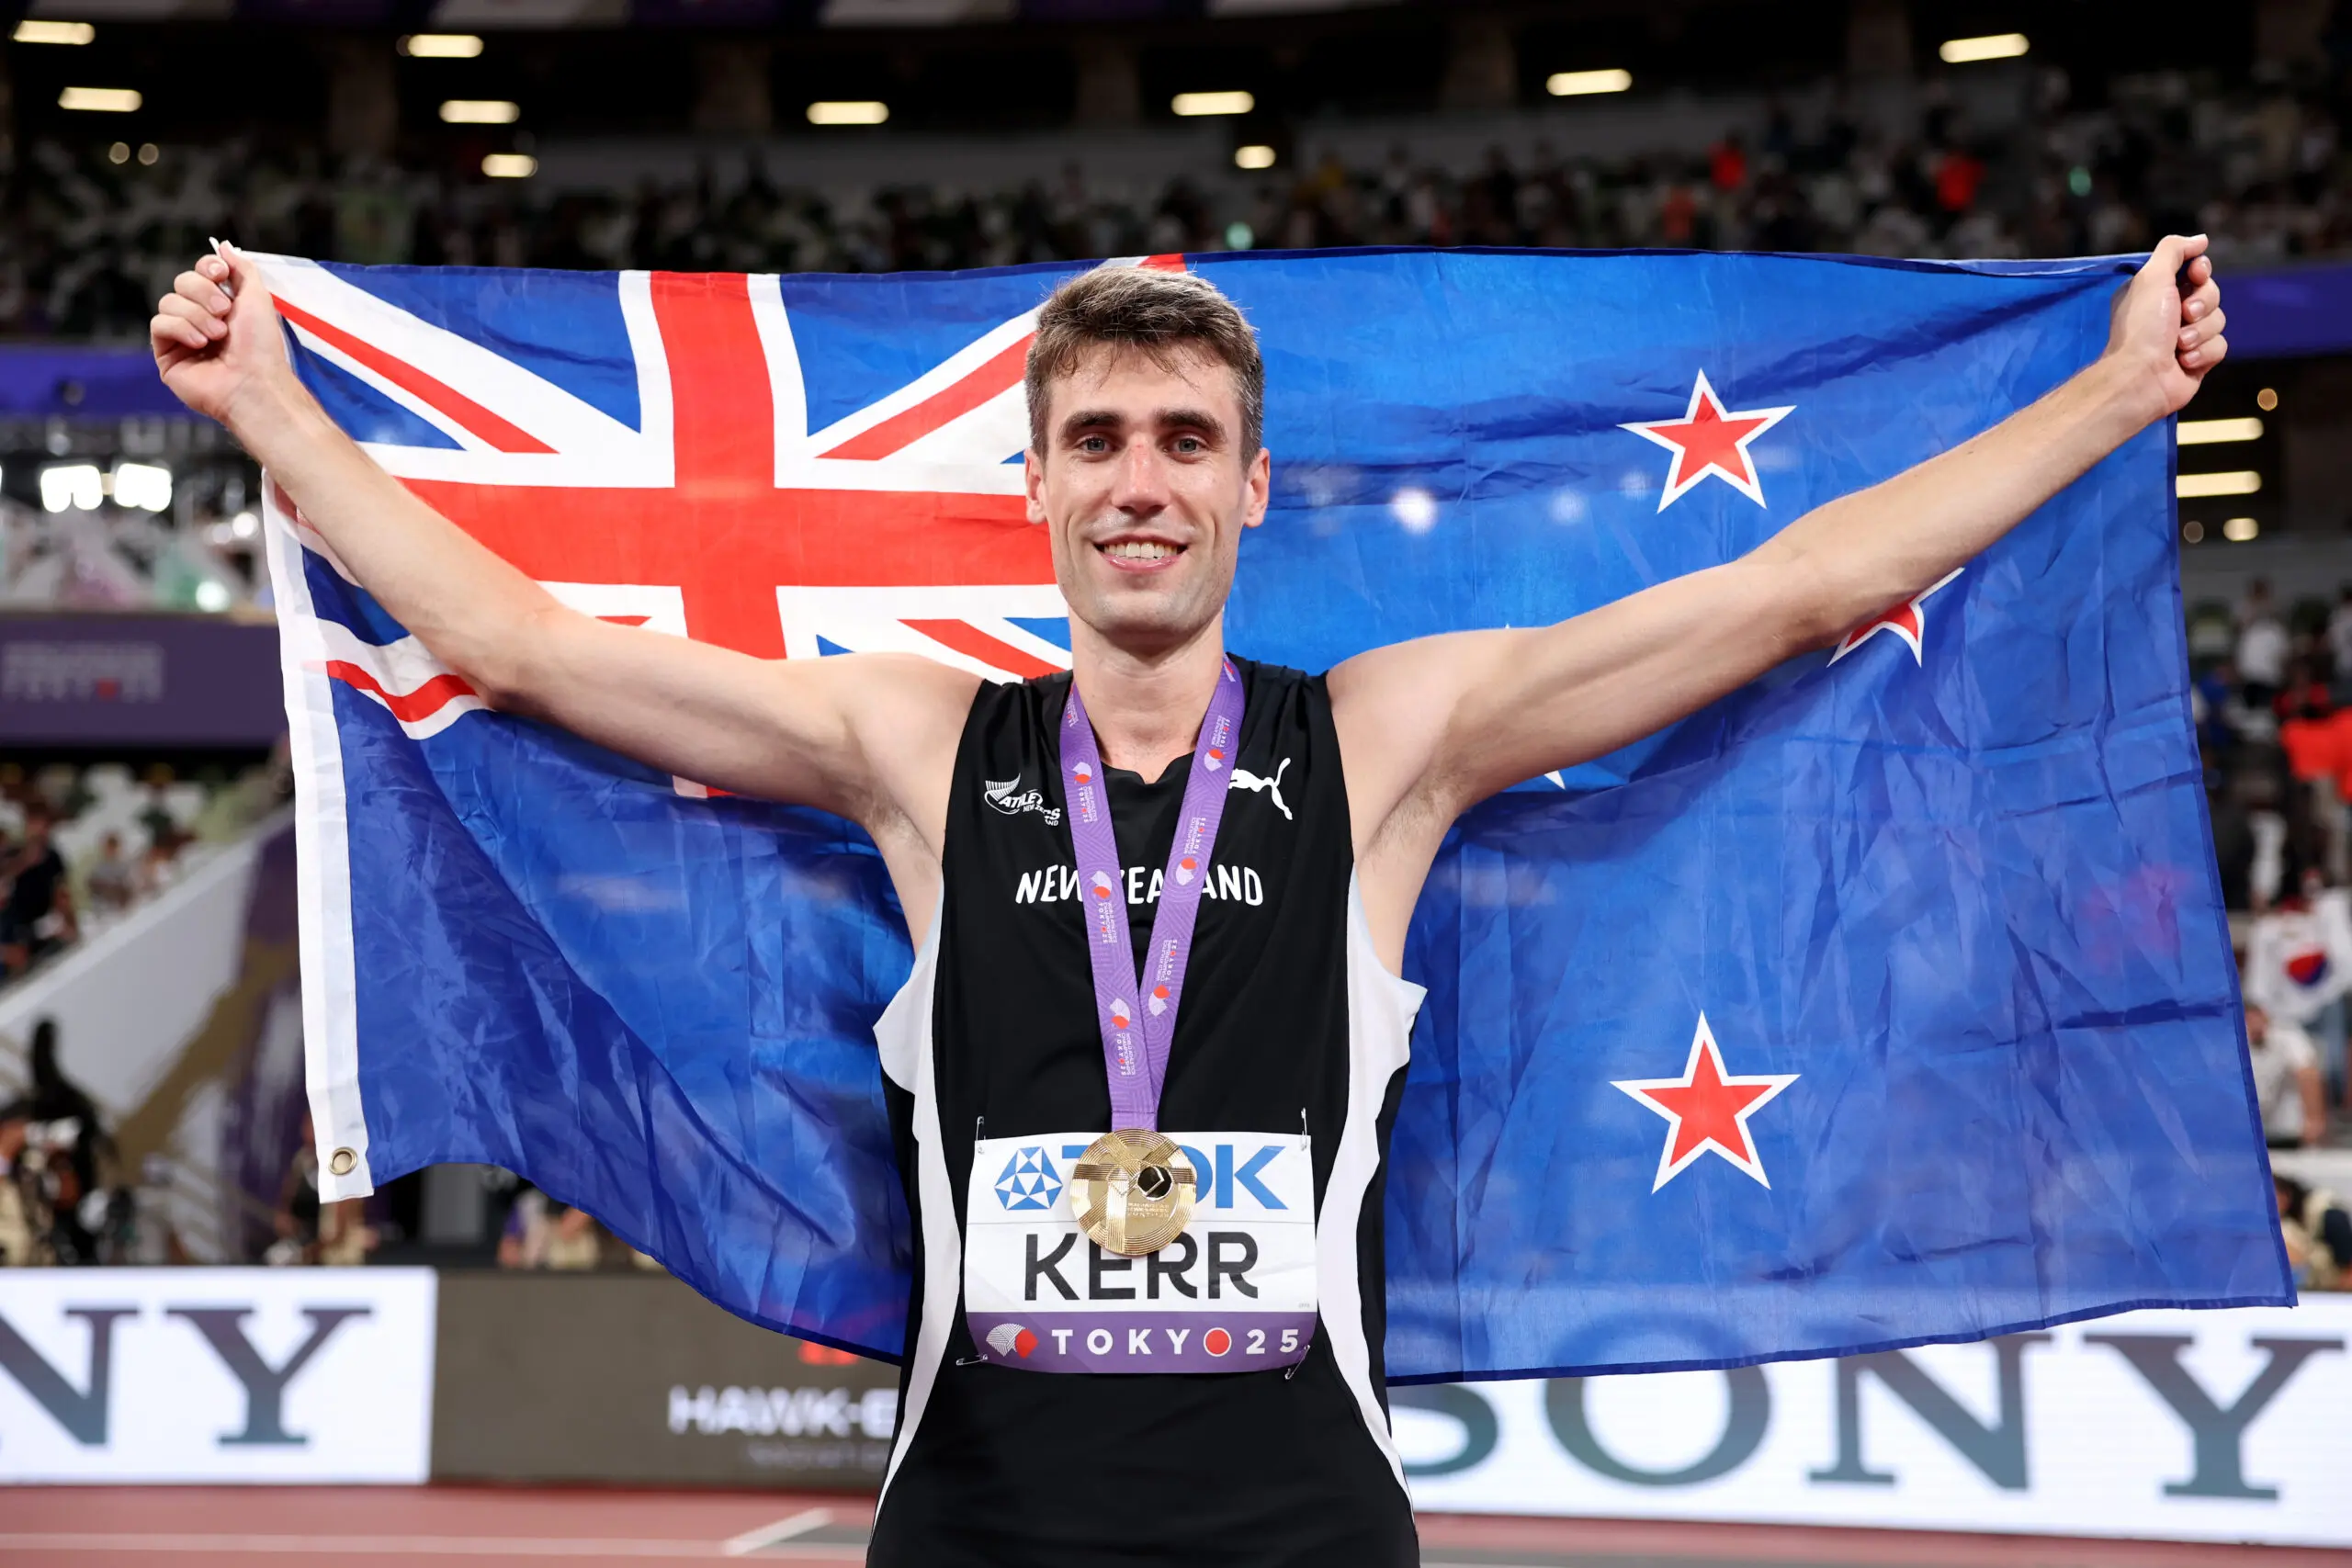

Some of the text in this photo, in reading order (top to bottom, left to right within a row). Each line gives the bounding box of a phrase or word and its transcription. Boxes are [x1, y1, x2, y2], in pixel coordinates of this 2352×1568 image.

[1015, 863, 1263, 907] NEW EAAND
[1115, 1032, 1125, 1064] TOKYO
[1024, 1232, 1258, 1301] KERR
[1051, 1327, 1298, 1357] TOKYO 25
